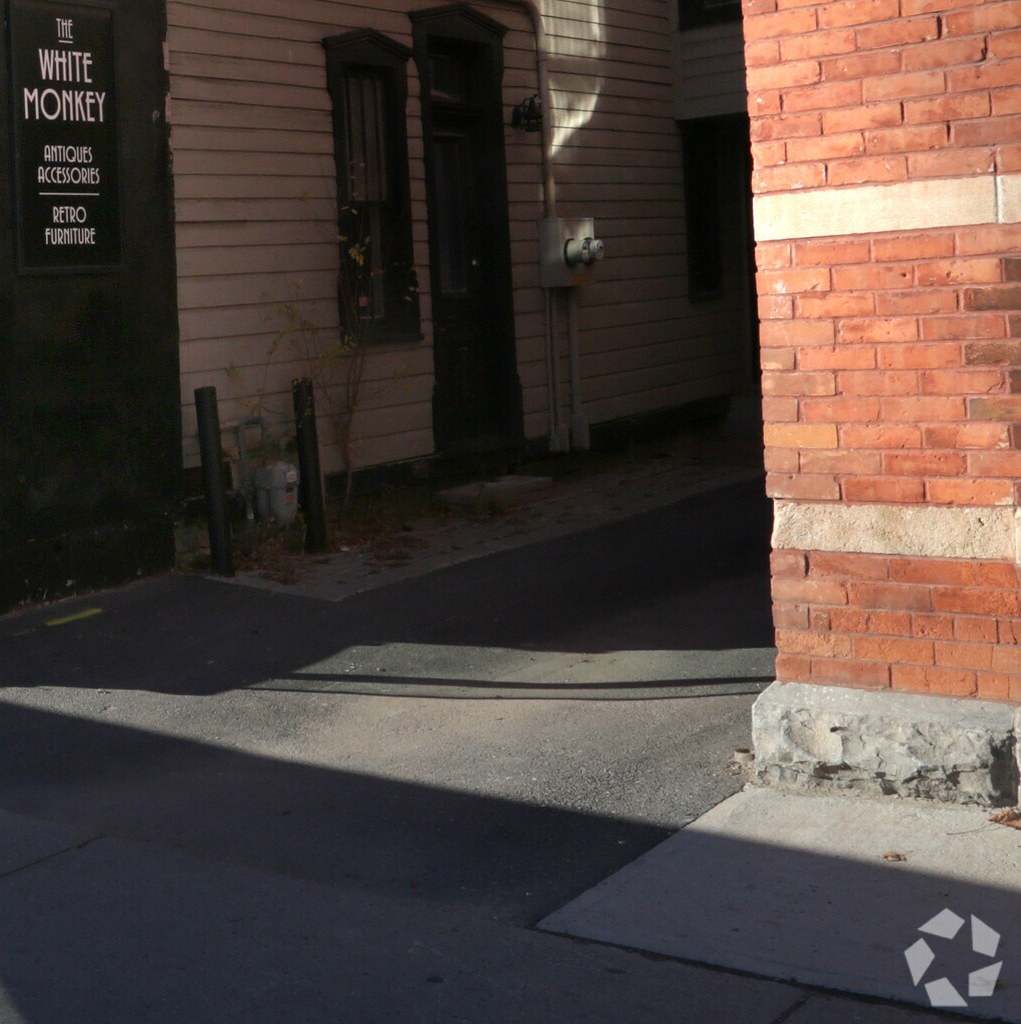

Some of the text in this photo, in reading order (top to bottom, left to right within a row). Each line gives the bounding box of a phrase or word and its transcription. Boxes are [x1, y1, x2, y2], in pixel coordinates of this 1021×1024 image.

[56, 18, 73, 39] THE
[38, 48, 93, 83] WHITE
[23, 88, 106, 122] MONKEY
[44, 145, 93, 163] ANTIQUES
[38, 166, 100, 184] ACCESSORIES
[53, 206, 87, 224] RETRO
[45, 228, 96, 245] FURNITURE
